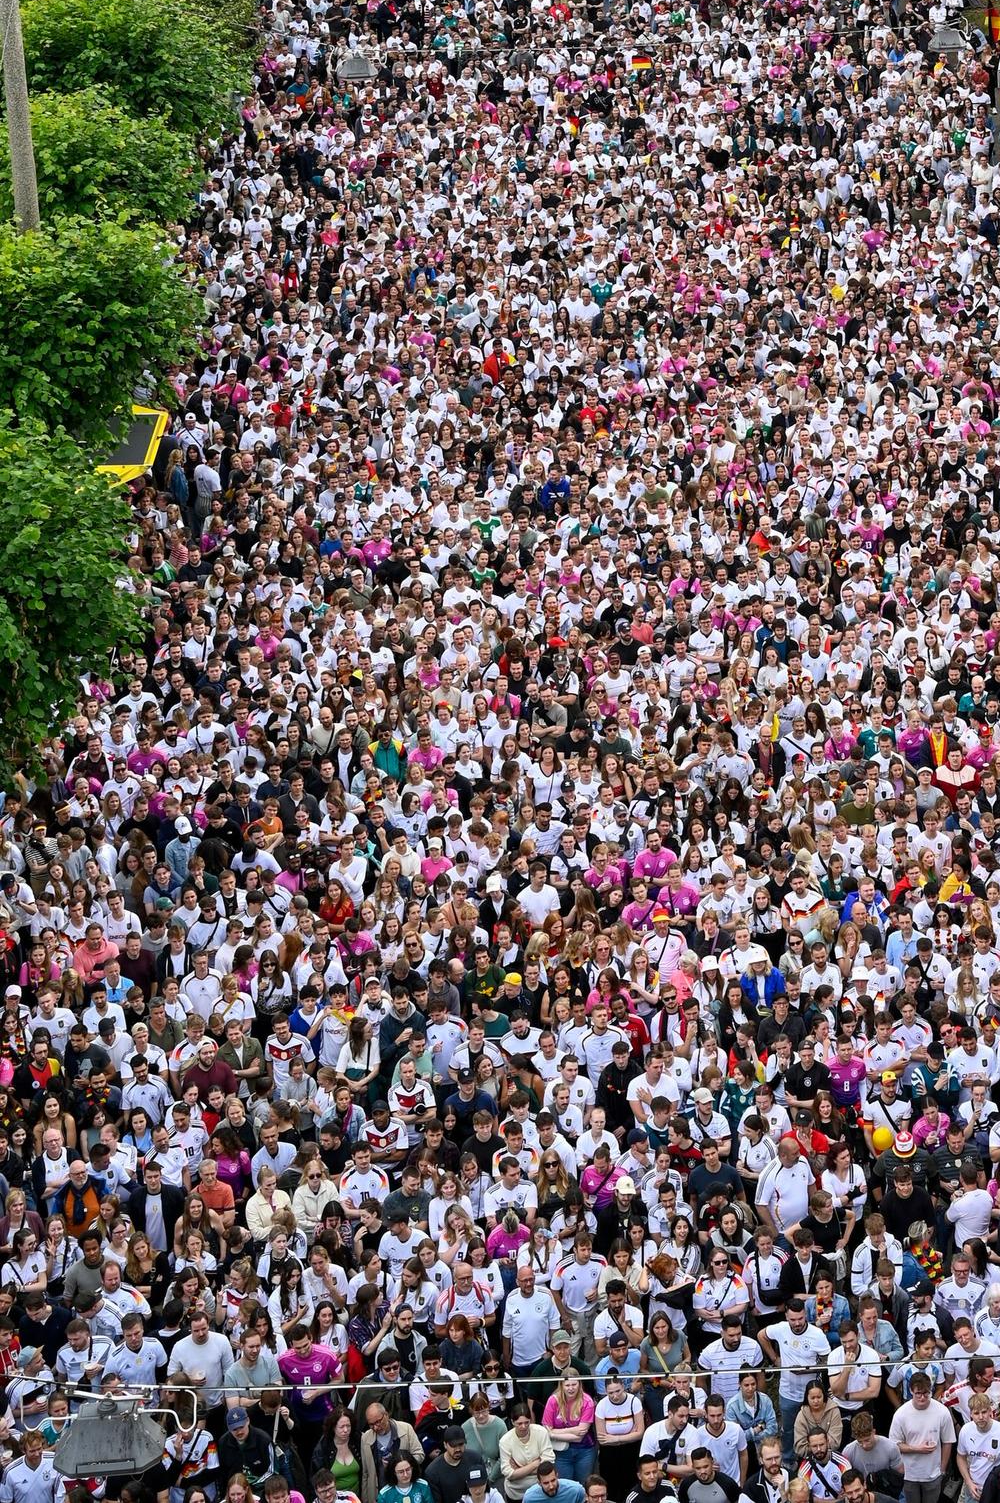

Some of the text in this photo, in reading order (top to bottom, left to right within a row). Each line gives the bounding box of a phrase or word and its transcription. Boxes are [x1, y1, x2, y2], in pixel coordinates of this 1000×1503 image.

[844, 1081, 850, 1092] 8
[184, 1147, 194, 1158] 10
[765, 1278, 770, 1287] 9
